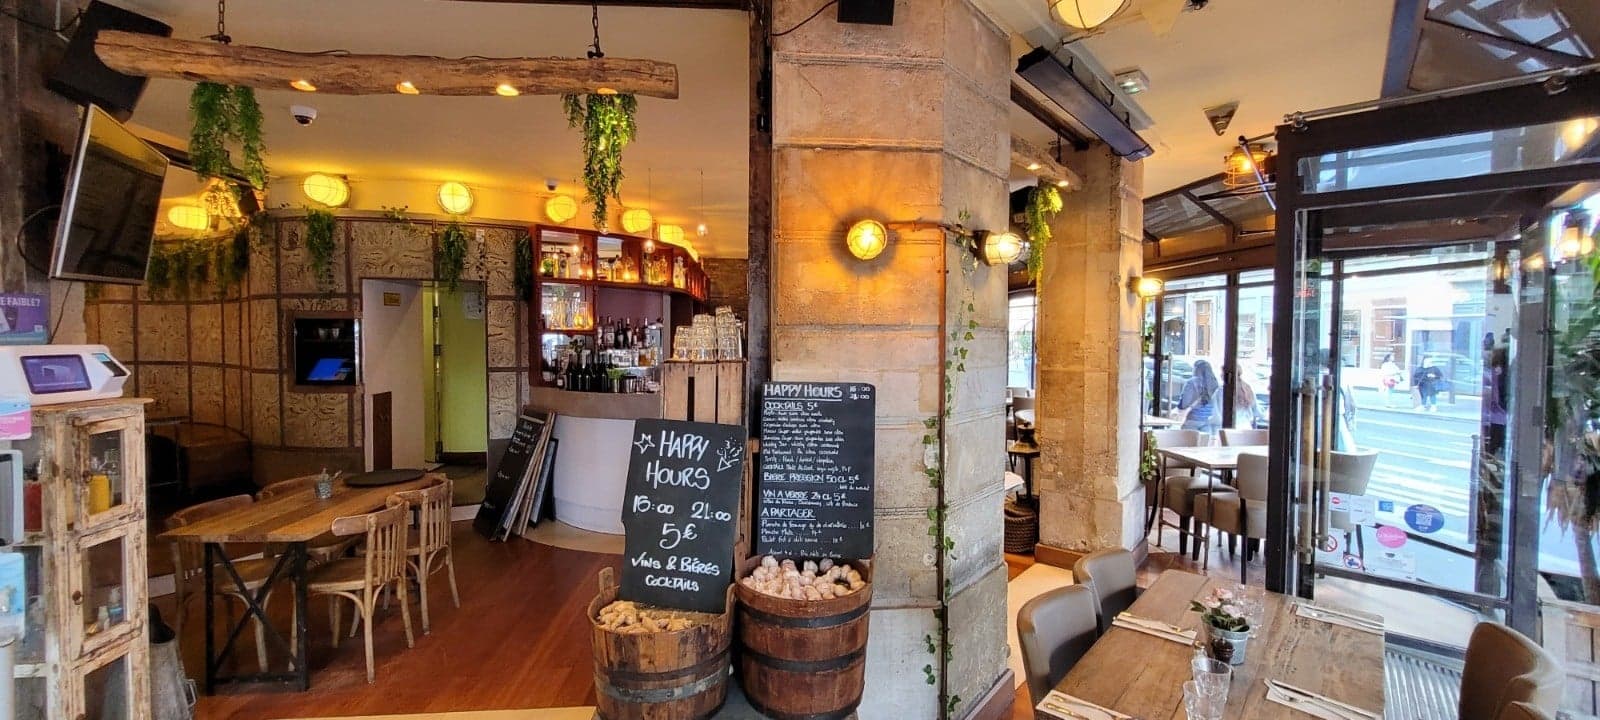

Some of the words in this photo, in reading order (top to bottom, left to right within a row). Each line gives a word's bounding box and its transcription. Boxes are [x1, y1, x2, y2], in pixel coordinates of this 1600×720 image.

[7, 297, 41, 307] FAIBLE?
[764, 384, 802, 397] HAPPY
[804, 384, 842, 398] HOURS
[659, 430, 710, 461] HAPPY
[645, 460, 711, 489] HOURS
[691, 501, 731, 521] 21:00
[761, 508, 770, 517] A
[659, 522, 698, 549] 5€
[631, 552, 662, 570] VINS
[665, 555, 677, 571] &
[645, 574, 700, 591] COCKTAILS
